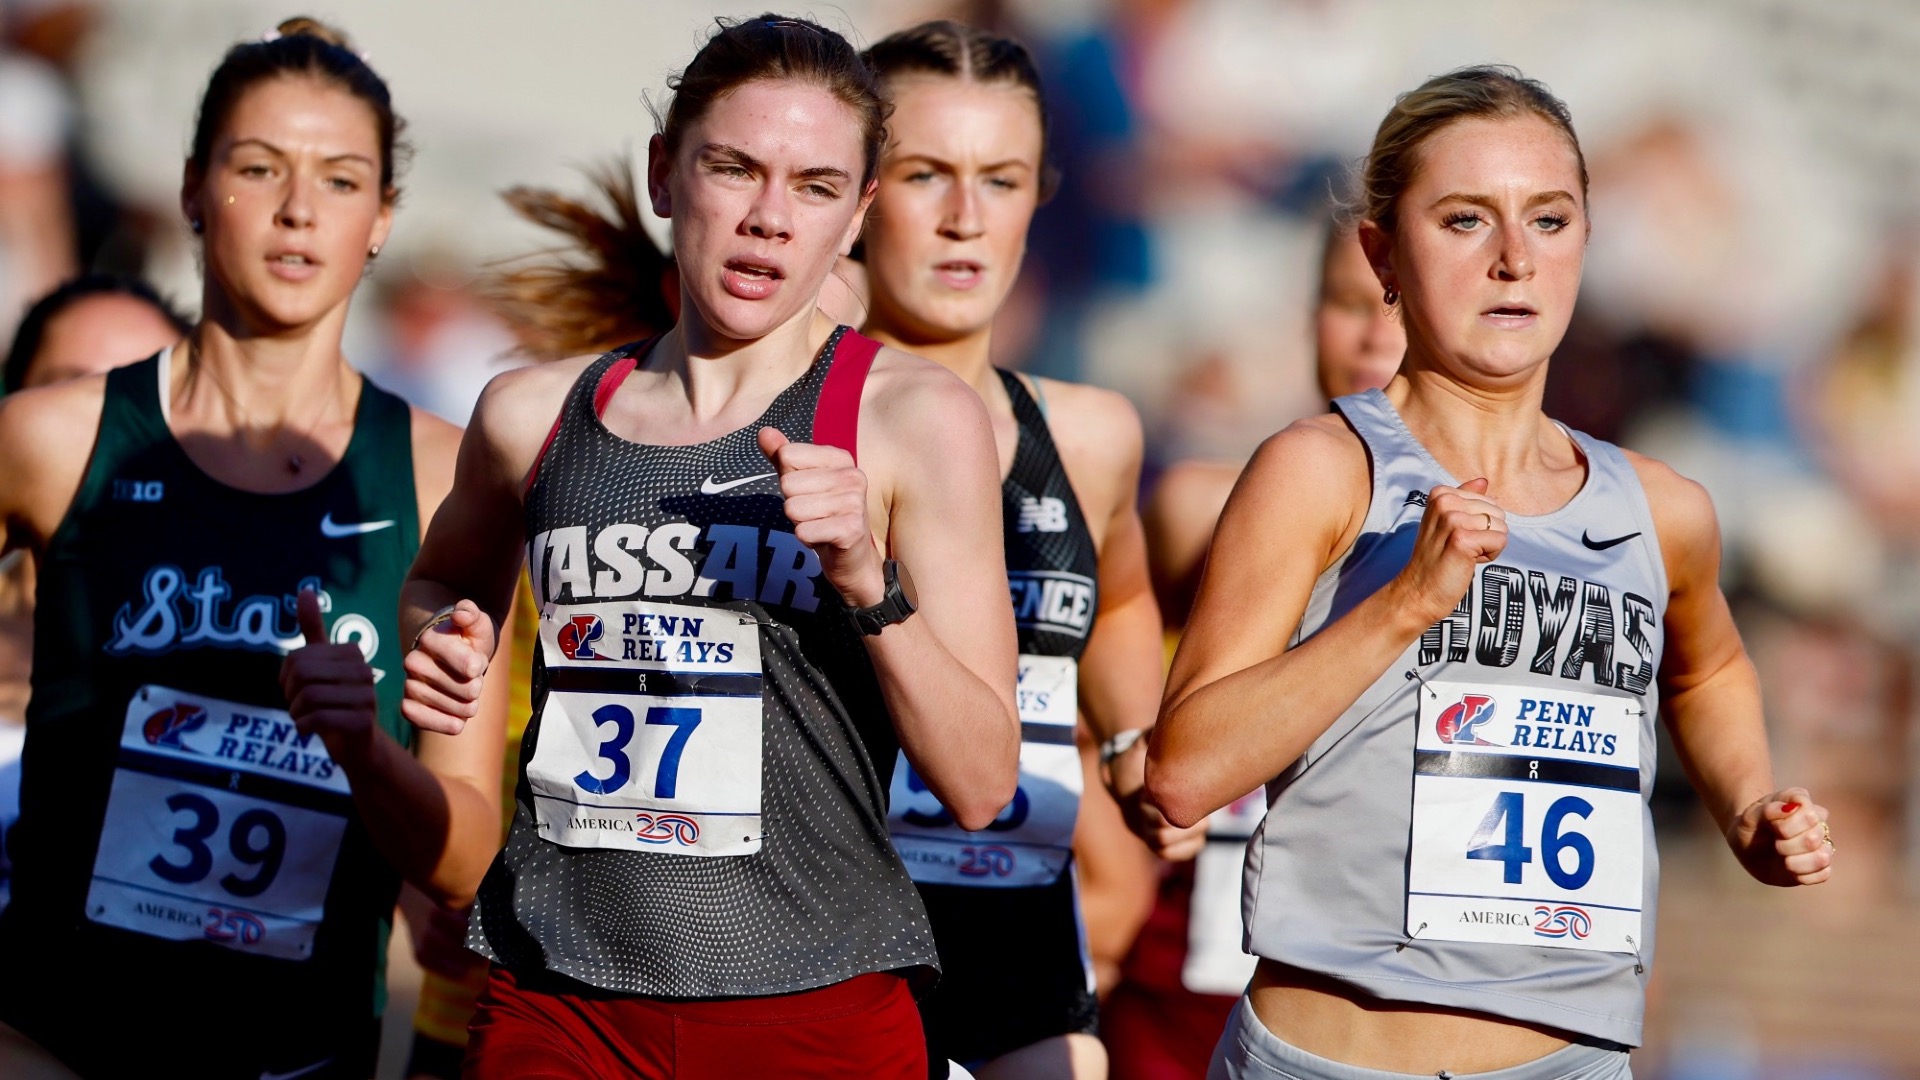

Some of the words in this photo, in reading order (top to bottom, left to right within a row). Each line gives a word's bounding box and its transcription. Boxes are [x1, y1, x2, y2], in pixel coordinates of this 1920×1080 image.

[623, 613, 704, 637] PENN
[1418, 564, 1655, 696] HOYAS
[622, 638, 734, 663] RELAYS
[1516, 699, 1595, 727] PENN
[573, 704, 702, 799] 37
[1510, 725, 1617, 756] RELAYS
[215, 737, 337, 780] RELAYS
[149, 793, 286, 897] 39
[566, 817, 634, 832] AMERICA
[636, 813, 700, 846] 250
[1466, 792, 1595, 890] 46
[958, 846, 1016, 878] 250
[134, 902, 203, 926] AMERICA
[204, 908, 267, 944] 250
[1459, 911, 1530, 926] AMERICA
[1534, 905, 1592, 940] 250
